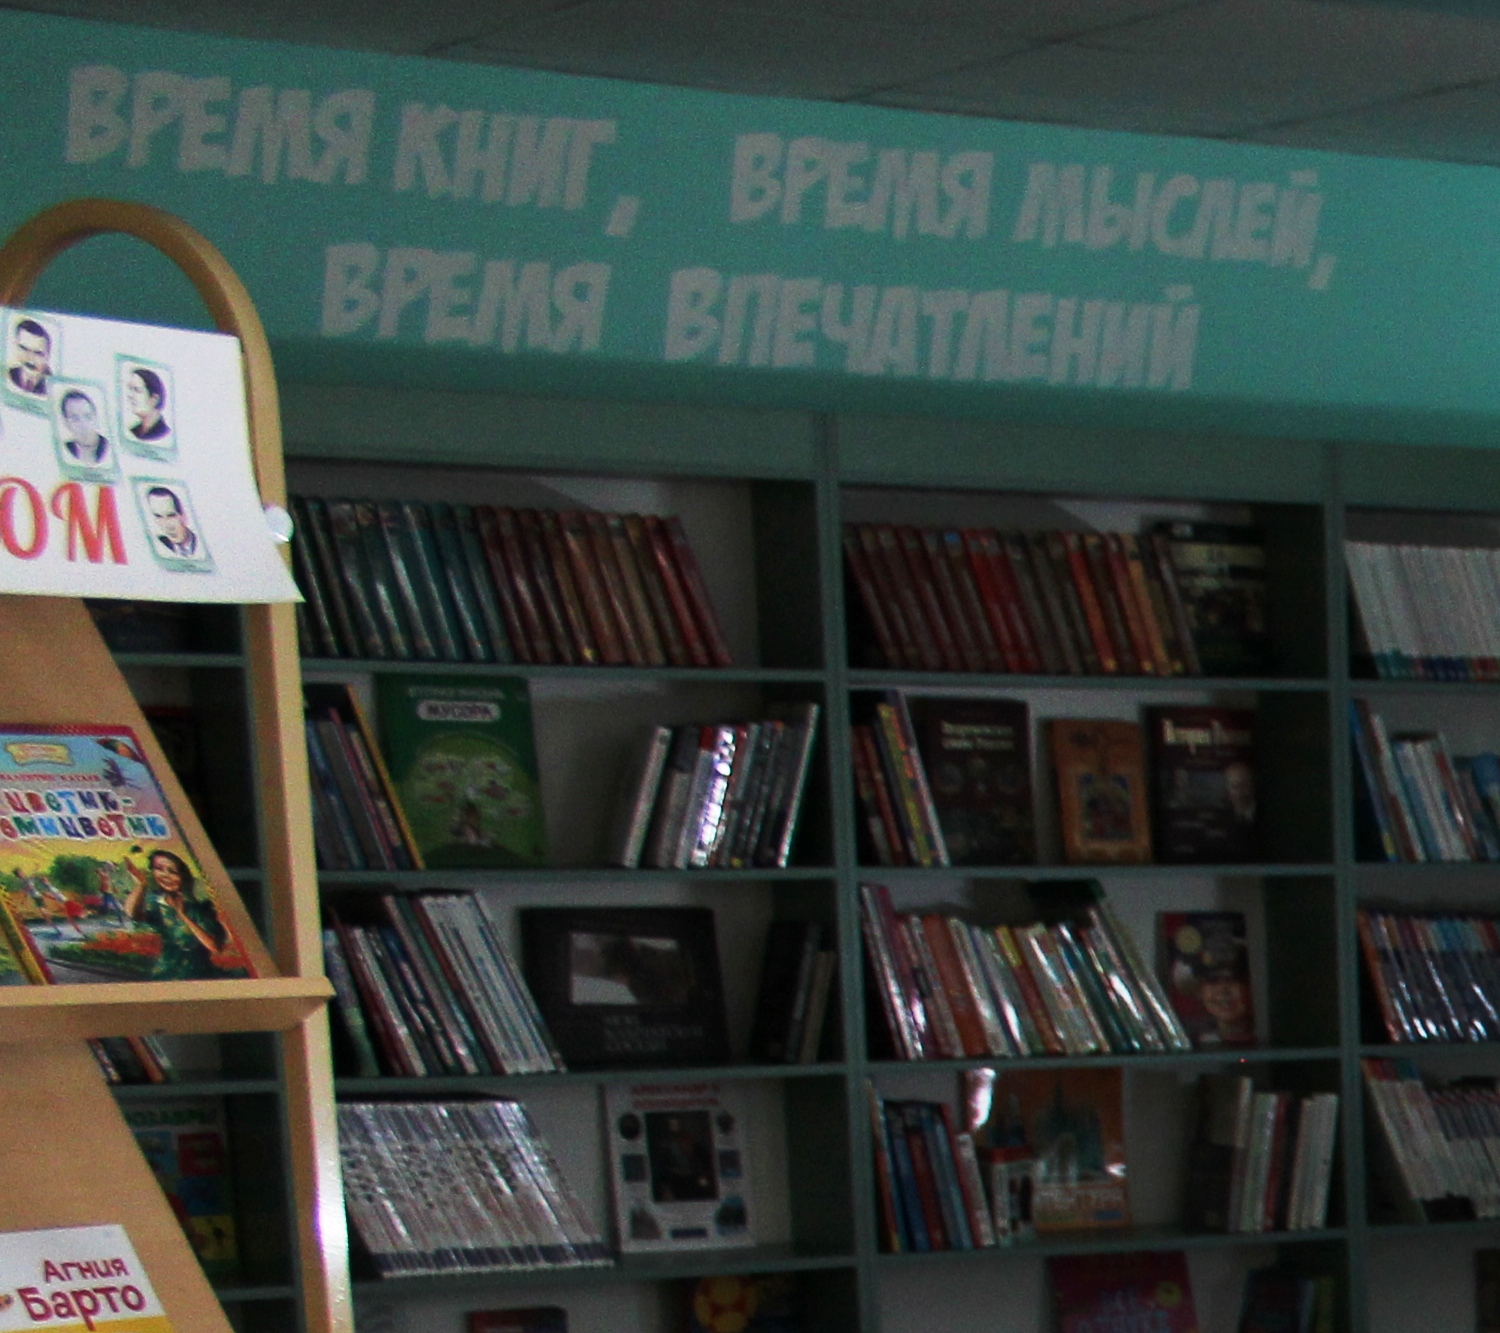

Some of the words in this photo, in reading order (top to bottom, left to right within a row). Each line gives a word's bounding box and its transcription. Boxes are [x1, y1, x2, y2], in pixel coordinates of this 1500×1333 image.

[65, 66, 373, 186] ВРЕМЯ
[396, 102, 642, 238] КНИГ,
[730, 131, 991, 240] ВРЕМЯ
[1013, 162, 1337, 291] МЫСЛЕЙ,
[321, 243, 611, 355] ВРЕМЯ
[664, 266, 1202, 392] ВПЕЧАТЛЕНИЙ
[16, 1284, 147, 1332] Барто
[43, 1257, 130, 1284] Агния
